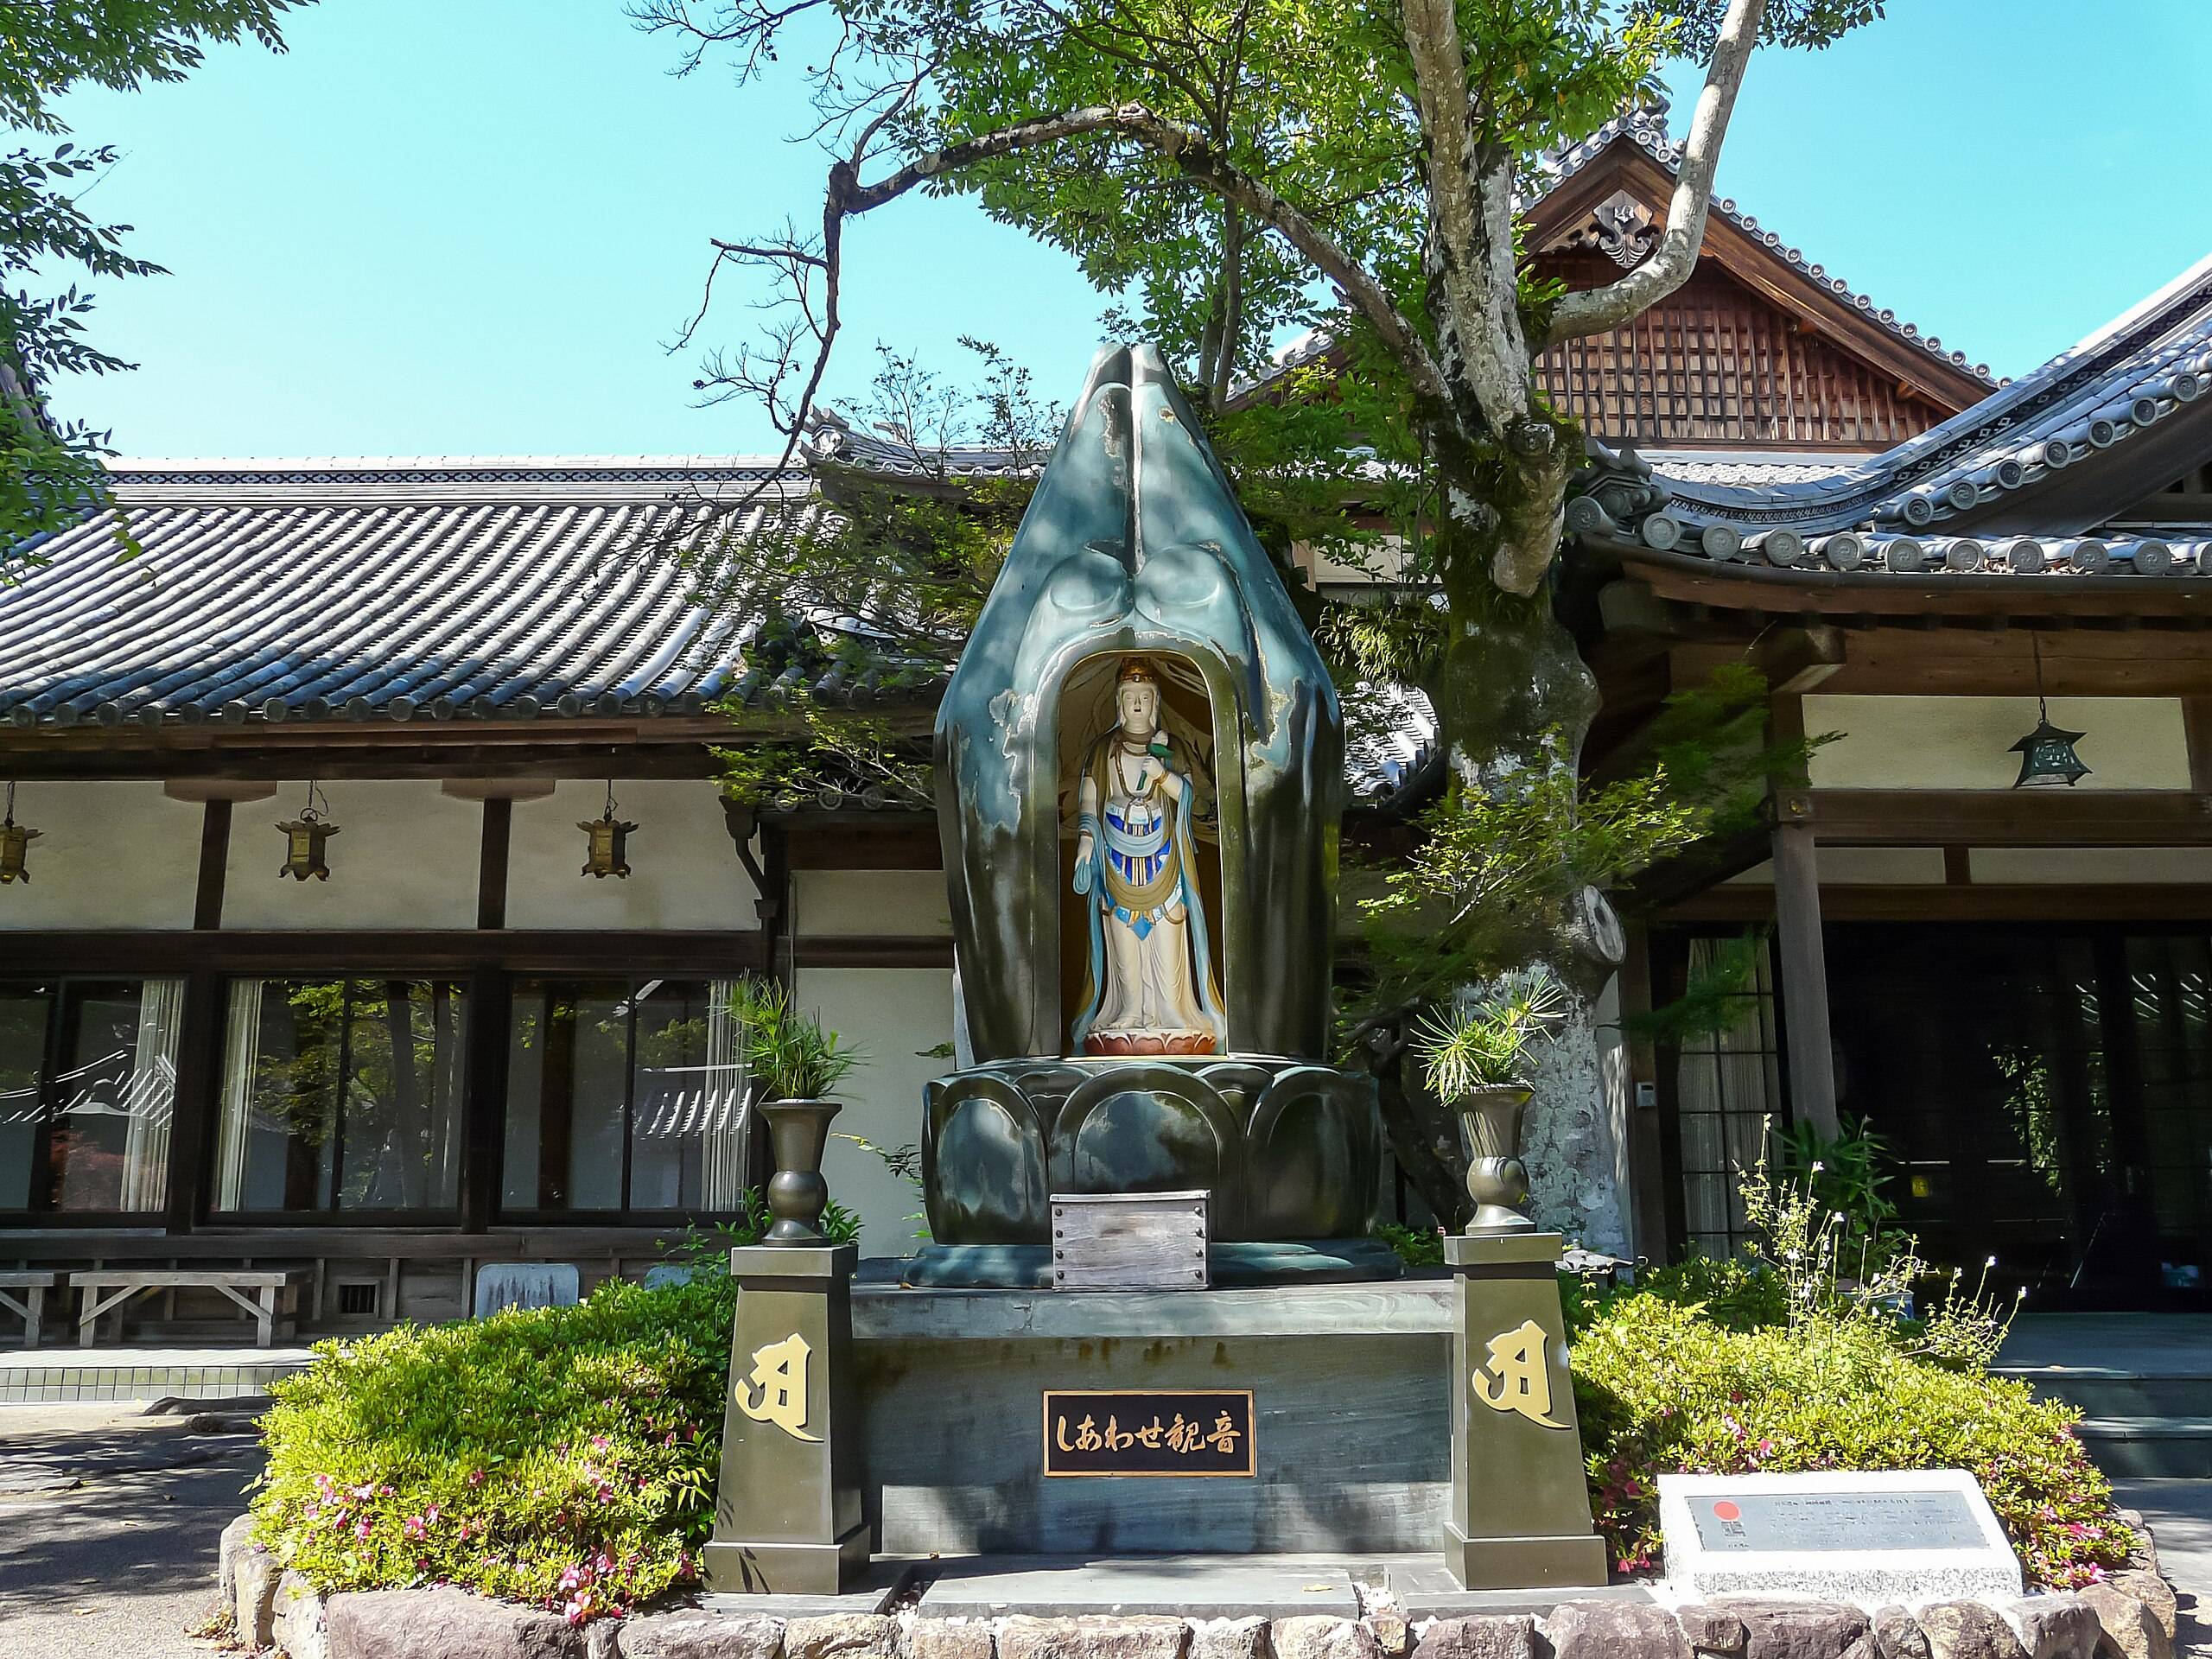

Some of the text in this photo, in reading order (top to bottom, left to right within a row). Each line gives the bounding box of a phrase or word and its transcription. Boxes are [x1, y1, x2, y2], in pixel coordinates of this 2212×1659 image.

[1056, 1409, 1242, 1453] しあわせ観音
